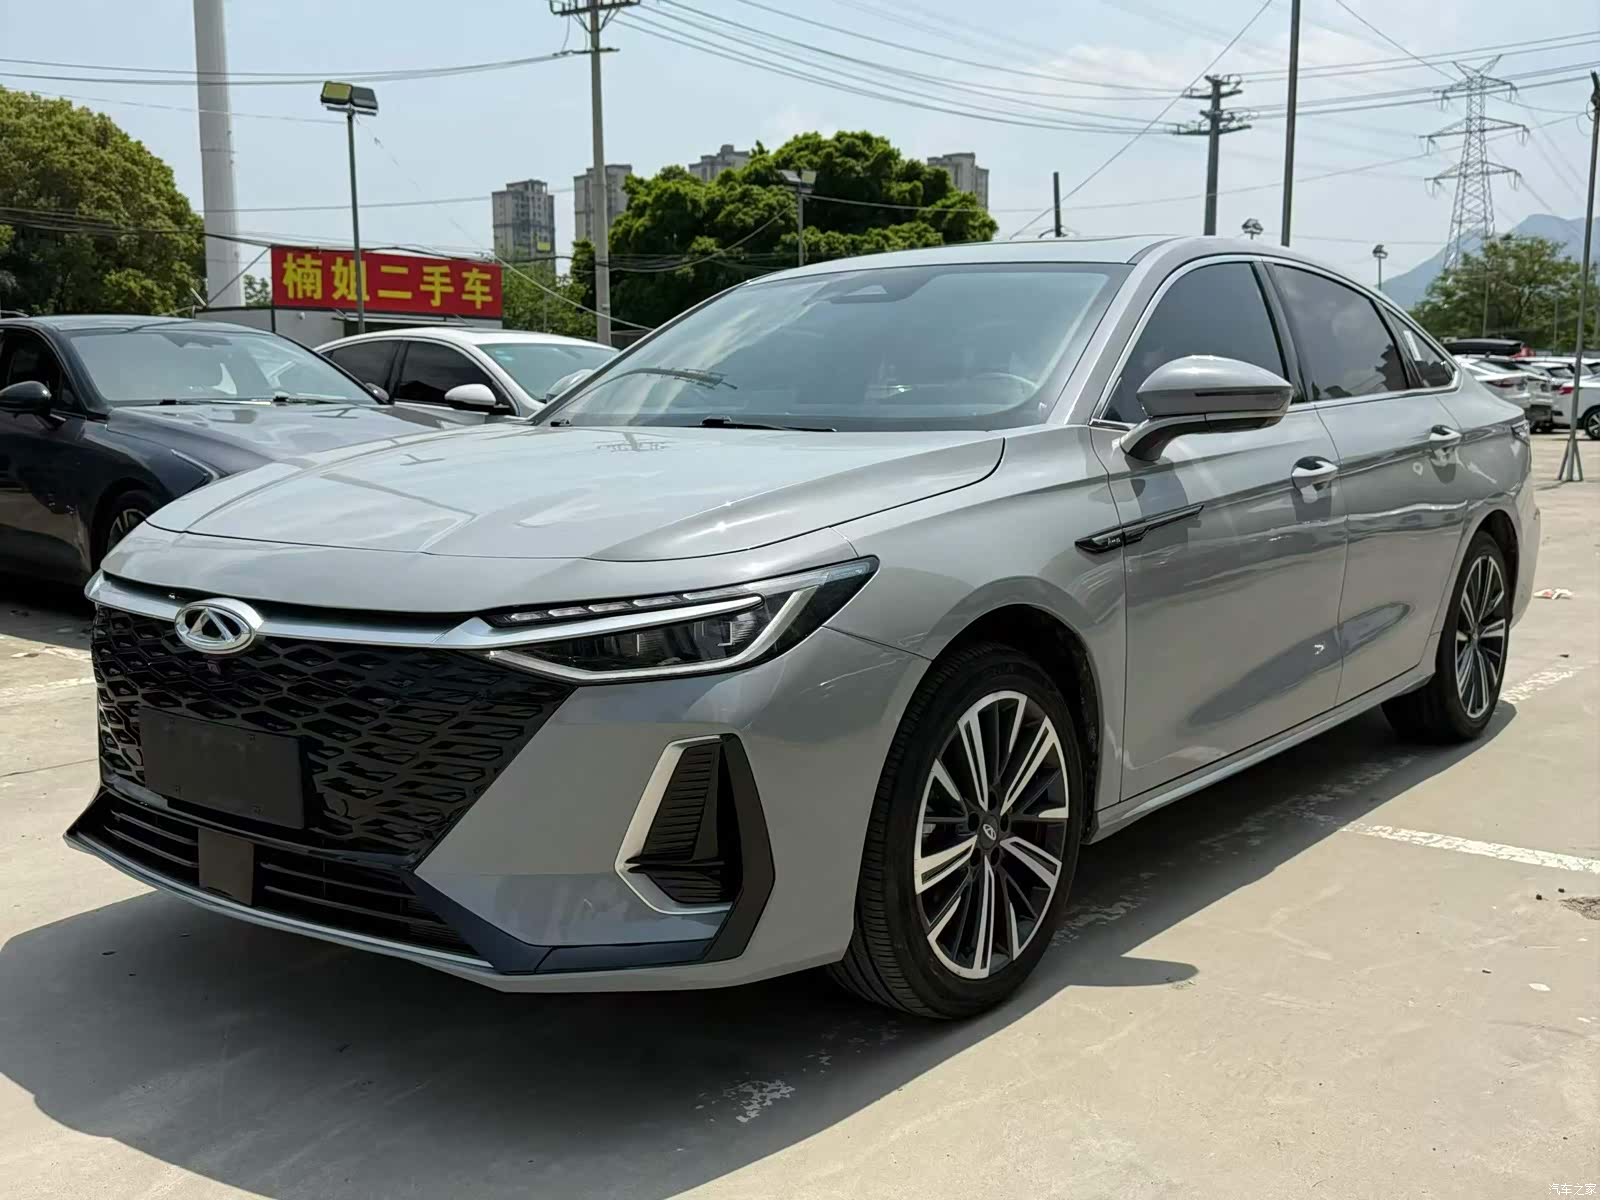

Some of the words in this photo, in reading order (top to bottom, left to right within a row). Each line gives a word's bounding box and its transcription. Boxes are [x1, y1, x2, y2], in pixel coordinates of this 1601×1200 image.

[282, 252, 493, 309] 楠姐二手车
